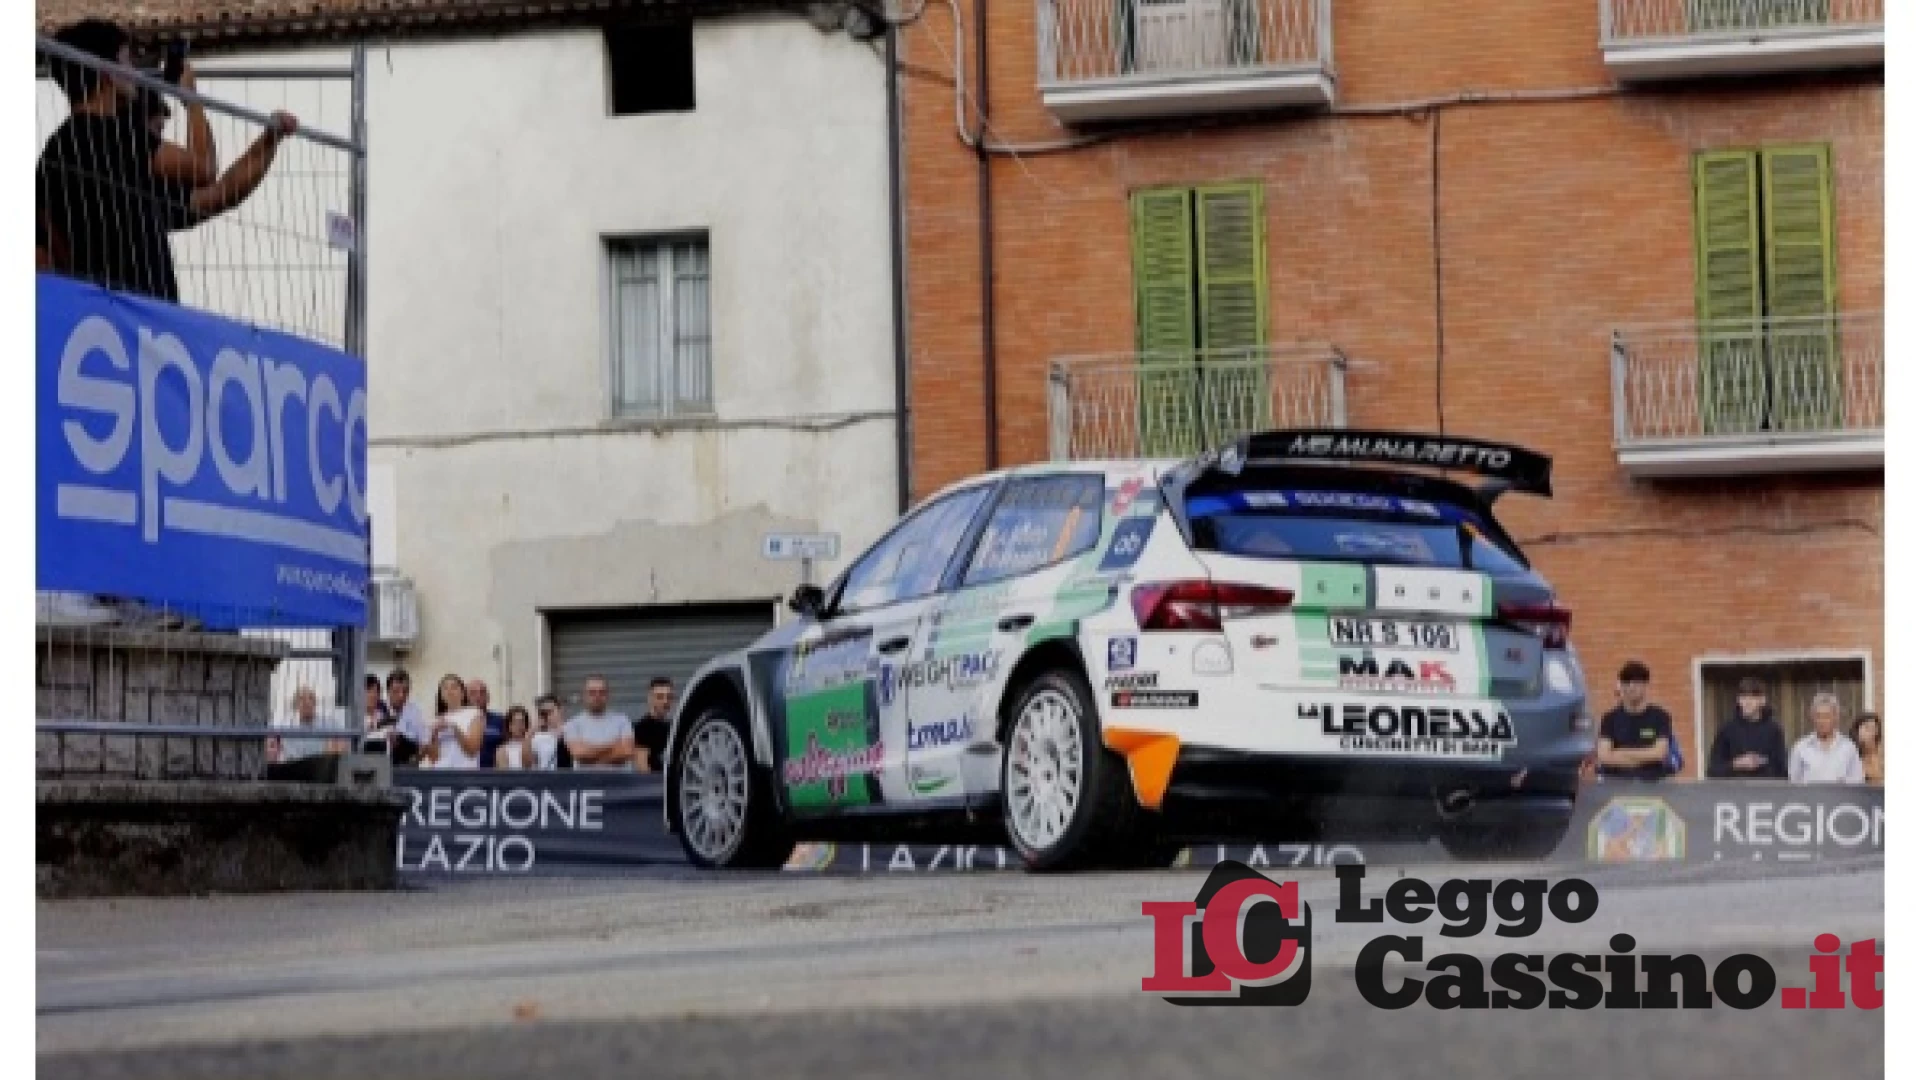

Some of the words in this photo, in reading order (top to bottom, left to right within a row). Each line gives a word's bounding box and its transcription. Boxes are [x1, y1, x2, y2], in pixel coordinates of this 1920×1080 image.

[1335, 437, 1512, 468] MUNARETTO
[1335, 621, 1372, 643] NR
[1338, 656, 1454, 684] MAK
[1321, 704, 1513, 740] LEONESSA
[396, 834, 536, 872] LAZIO
